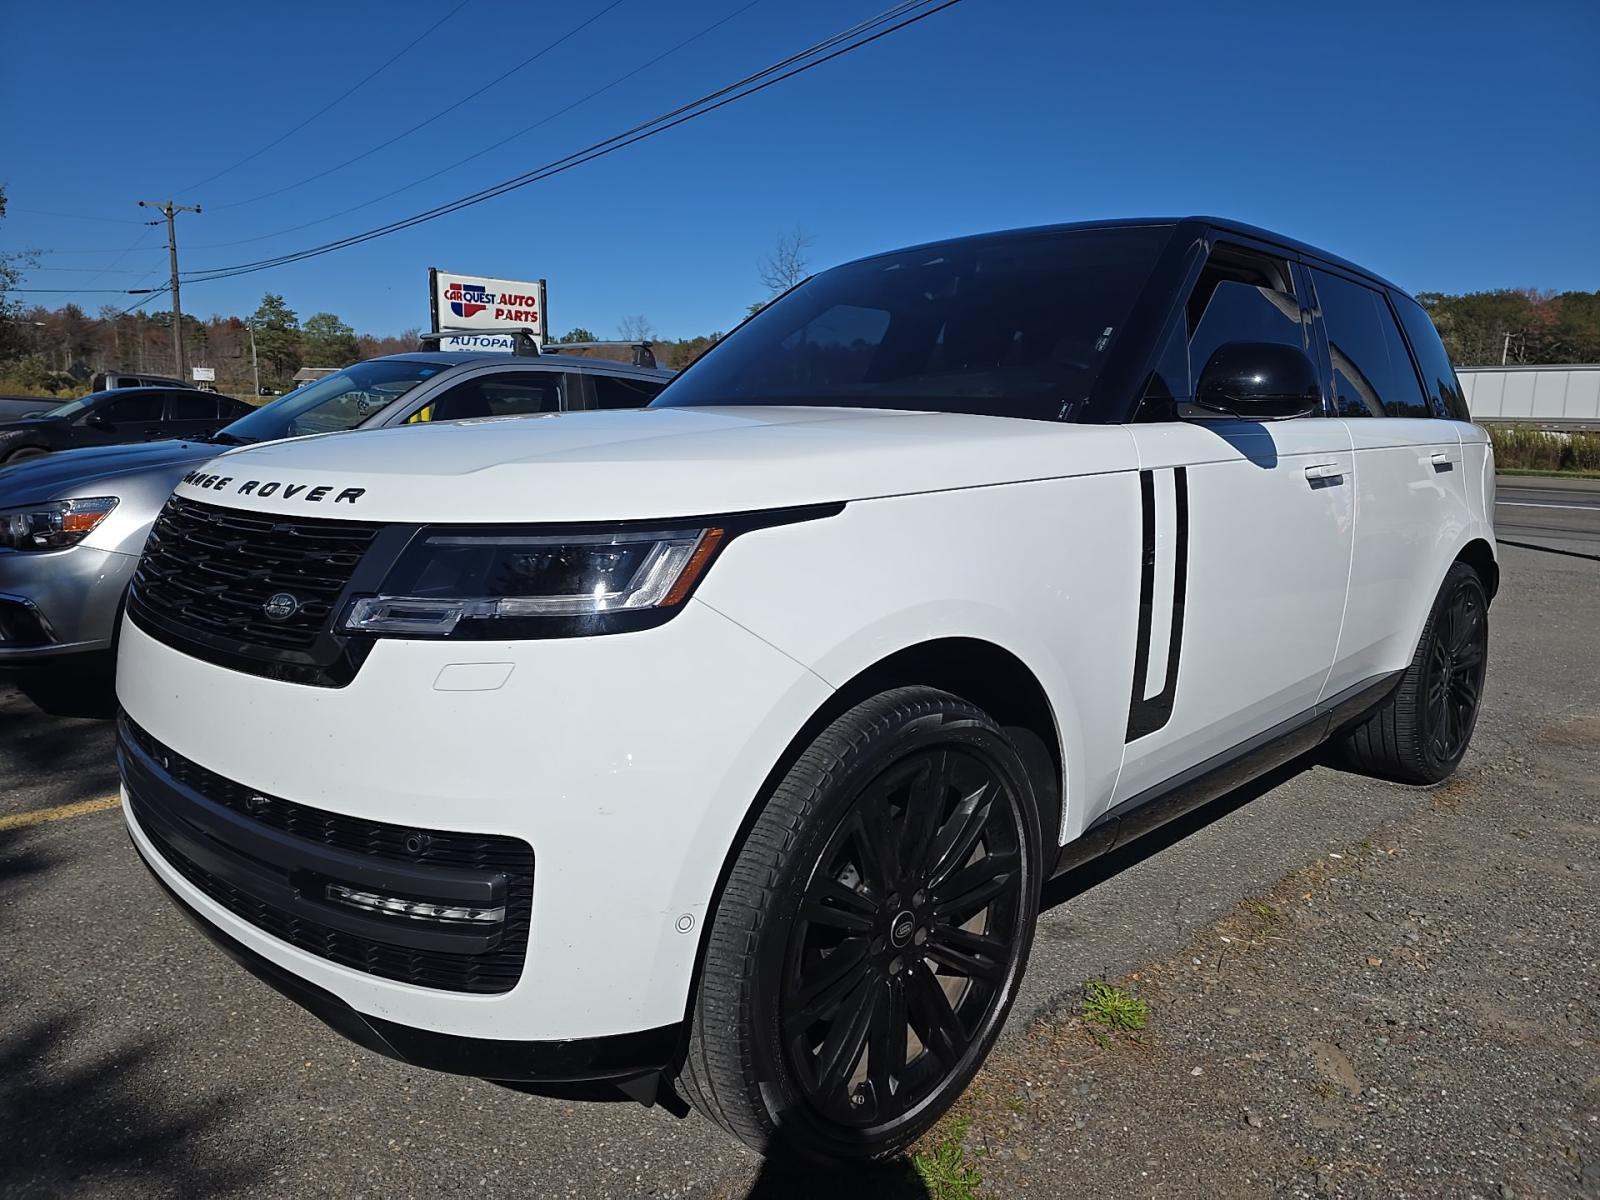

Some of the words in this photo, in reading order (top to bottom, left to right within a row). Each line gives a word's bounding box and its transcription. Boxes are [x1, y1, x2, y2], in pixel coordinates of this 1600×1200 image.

[498, 293, 536, 307] AUTO
[495, 308, 539, 322] PARTS
[237, 480, 366, 503] ROVER
